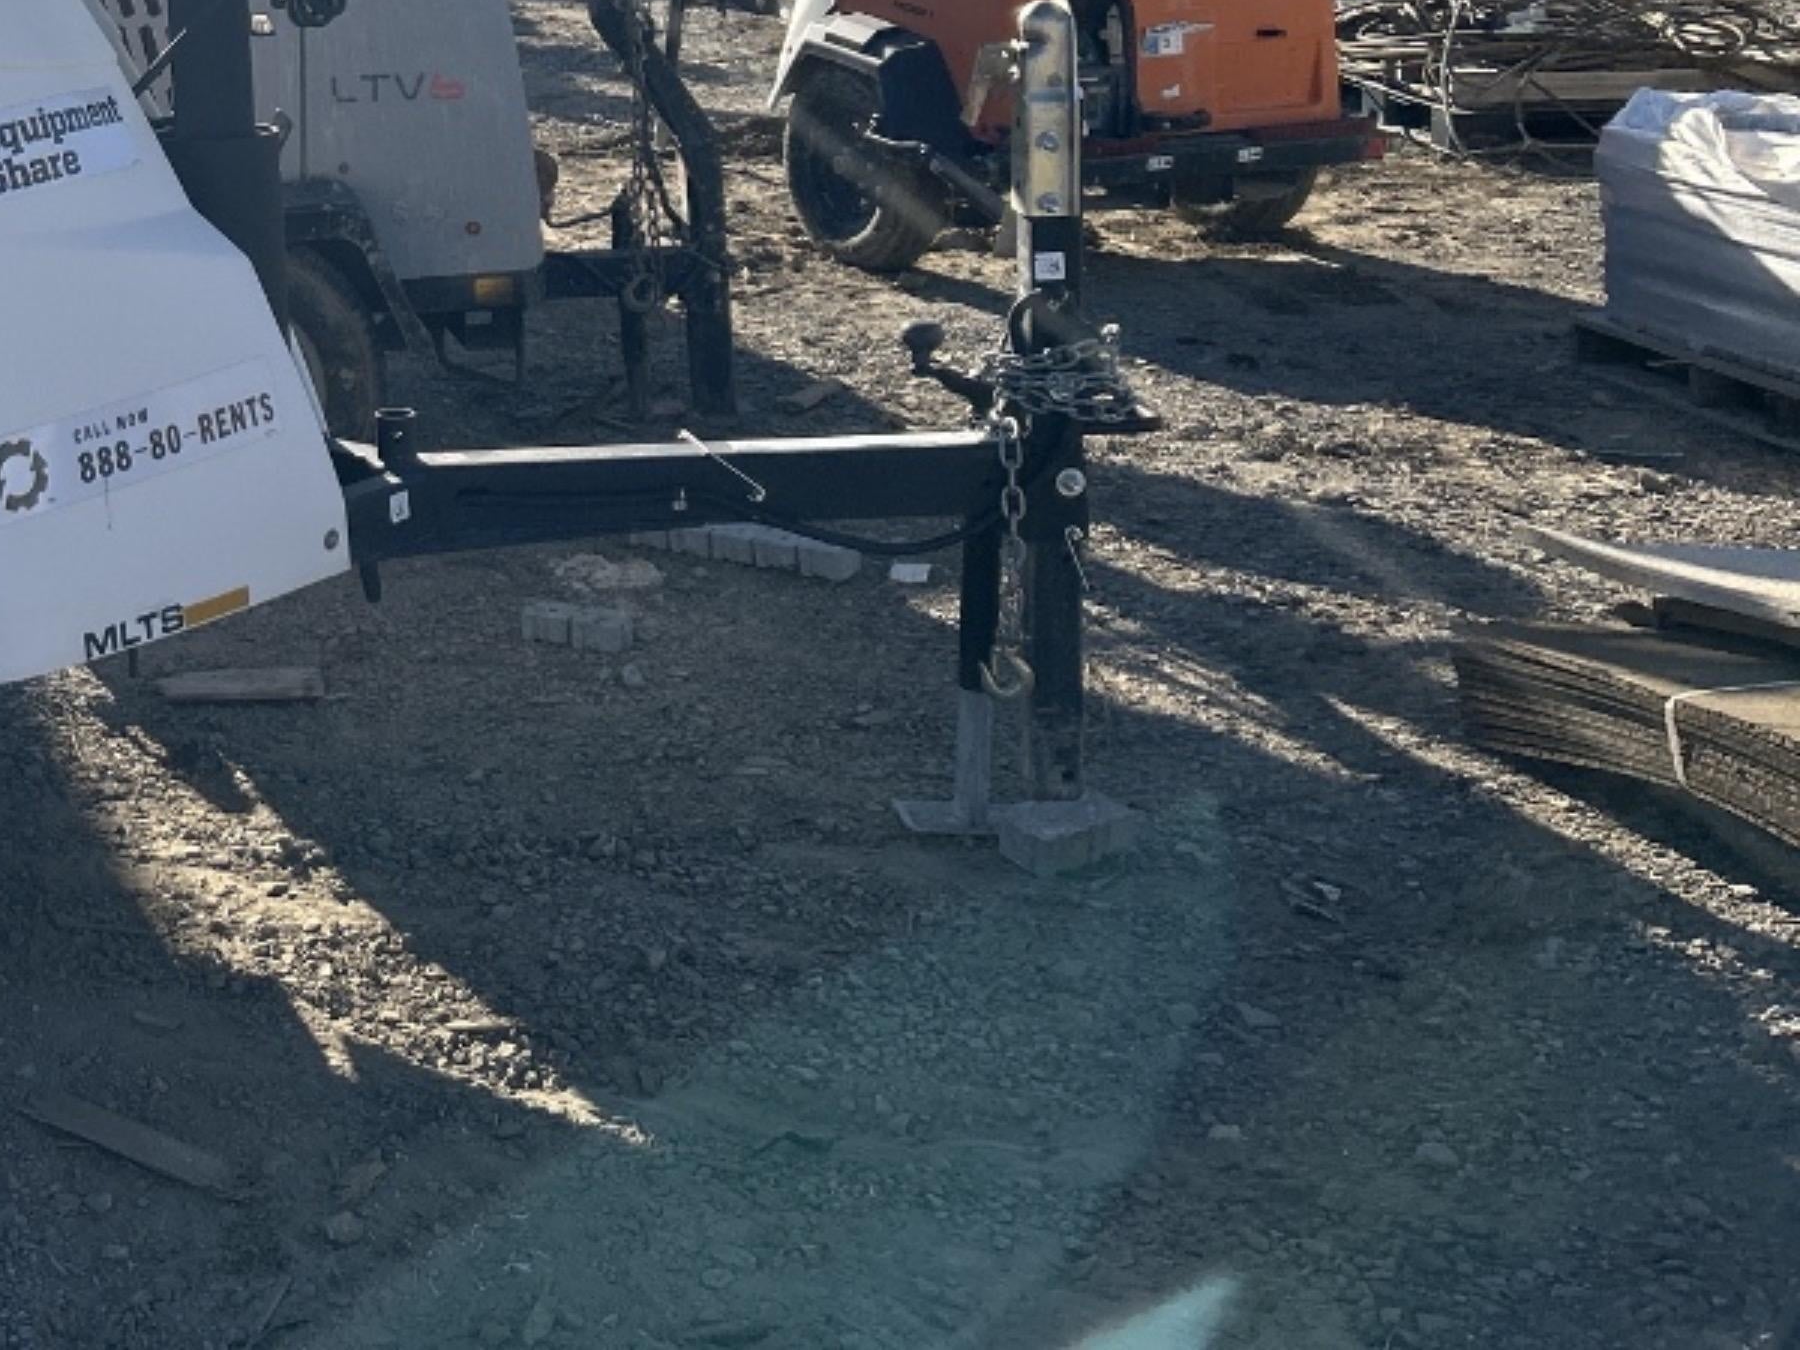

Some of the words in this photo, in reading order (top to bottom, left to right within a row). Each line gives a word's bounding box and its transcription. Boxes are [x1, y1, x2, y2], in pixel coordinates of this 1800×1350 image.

[73, 420, 112, 445] CALL
[116, 407, 149, 430] NOW
[77, 392, 275, 484] 888-80-RENTS
